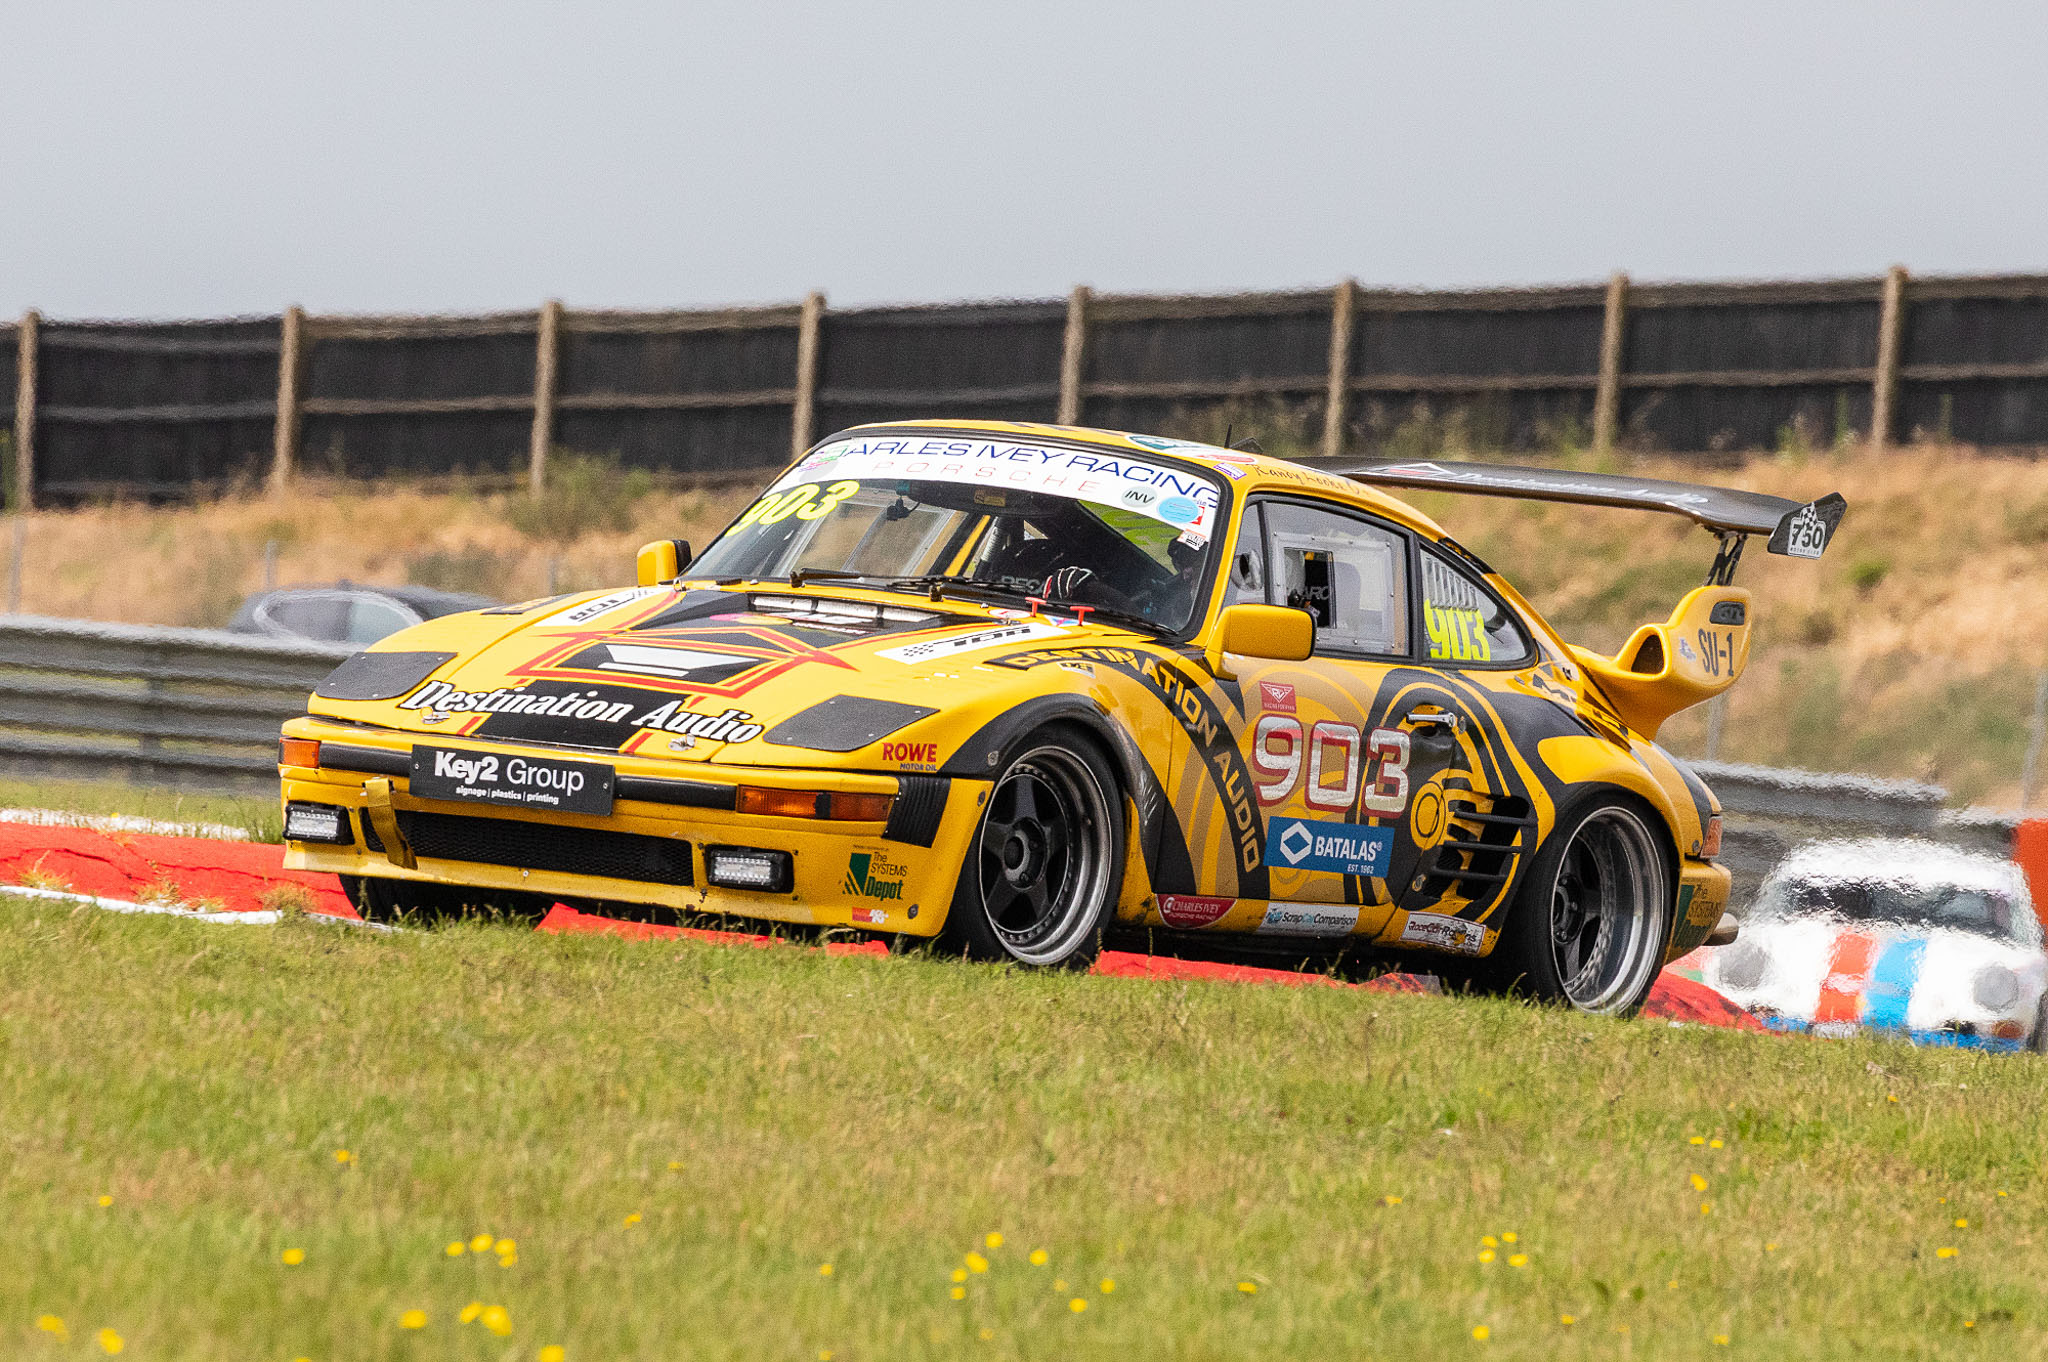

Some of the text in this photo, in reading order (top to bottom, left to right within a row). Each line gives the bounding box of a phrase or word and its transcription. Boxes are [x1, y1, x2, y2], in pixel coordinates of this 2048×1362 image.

[976, 444, 1065, 464] IVEY
[871, 461, 1101, 492] PORSCHE
[723, 479, 860, 537] 903
[1124, 490, 1155, 503] INV
[1791, 524, 1824, 549] 750
[1423, 598, 1491, 662] 903
[1697, 628, 1735, 677] SU-1
[402, 680, 764, 744] Destination Audio
[882, 743, 938, 762] ROWE
[1004, 648, 1261, 873] DESTINATION AUDIO
[434, 751, 585, 796] Key2 Group
[900, 763, 938, 772] MOTOR OIL
[1252, 713, 1411, 819] 903
[456, 785, 560, 805] signage plastics printing
[870, 862, 908, 877] SYSTEMS
[873, 851, 888, 863] The
[864, 876, 904, 902] Depot
